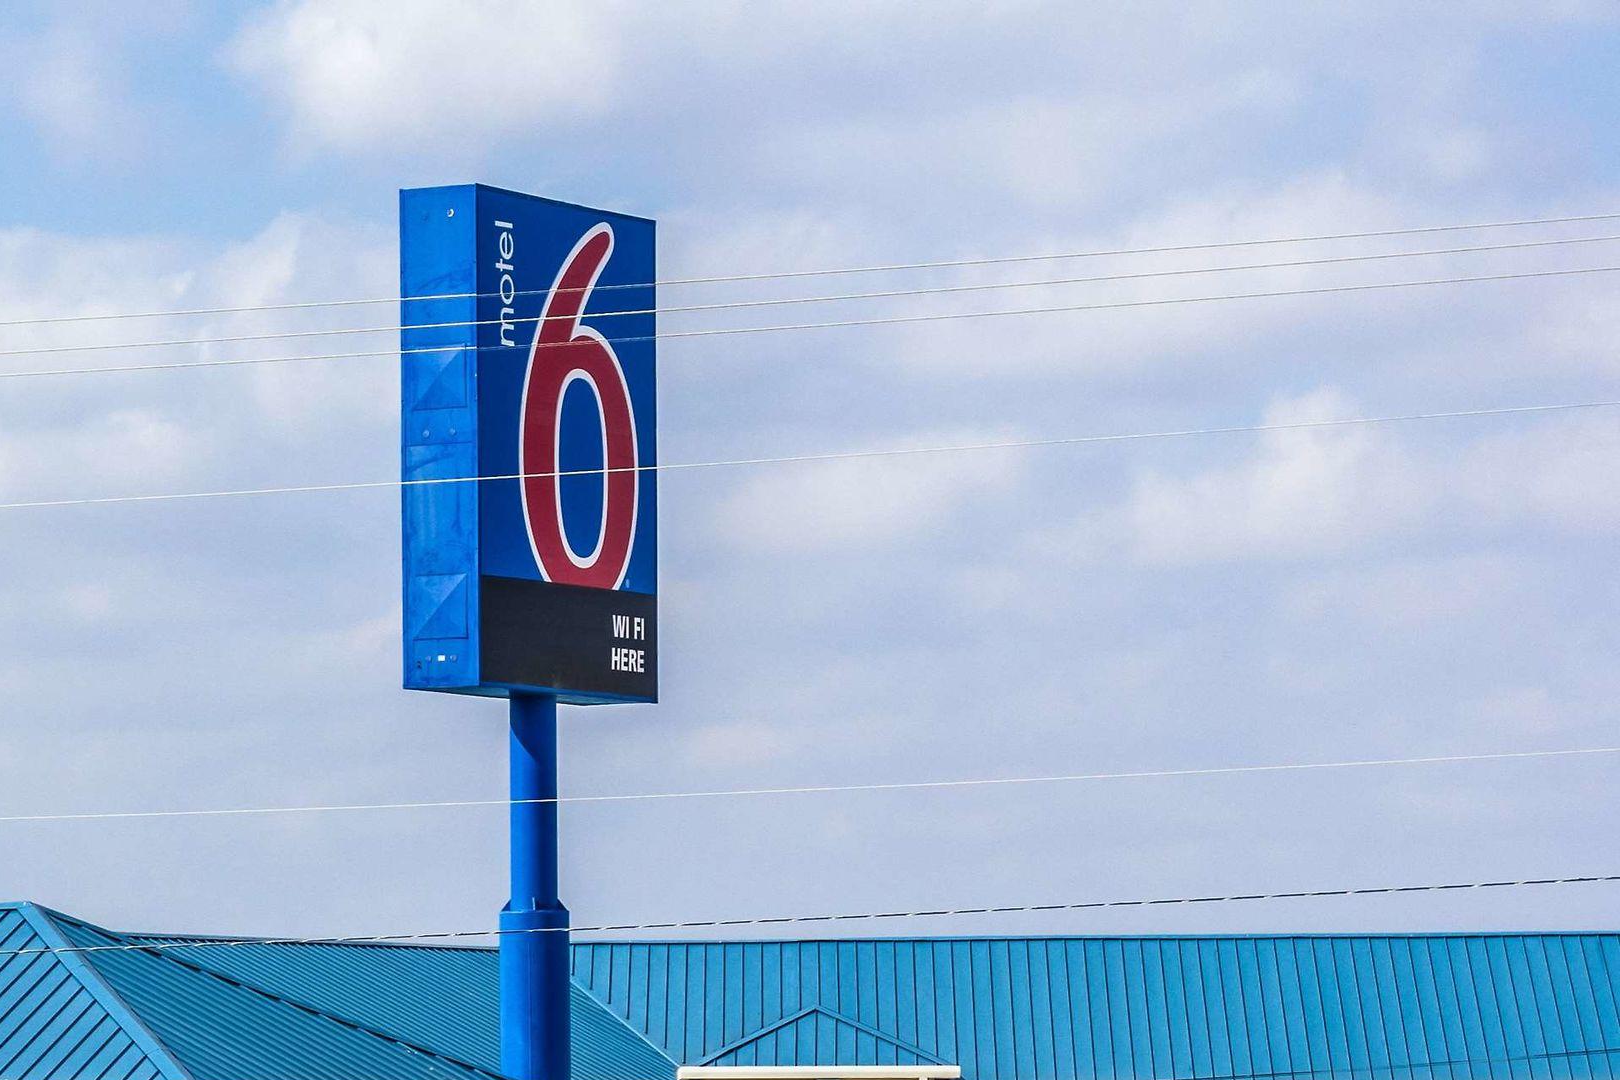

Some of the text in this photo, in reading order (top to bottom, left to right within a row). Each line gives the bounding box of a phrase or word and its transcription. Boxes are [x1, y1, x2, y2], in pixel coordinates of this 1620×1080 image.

[495, 220, 515, 347] motel
[518, 221, 639, 592] 6
[611, 647, 645, 673] HERE
[612, 614, 645, 640] WI FI
